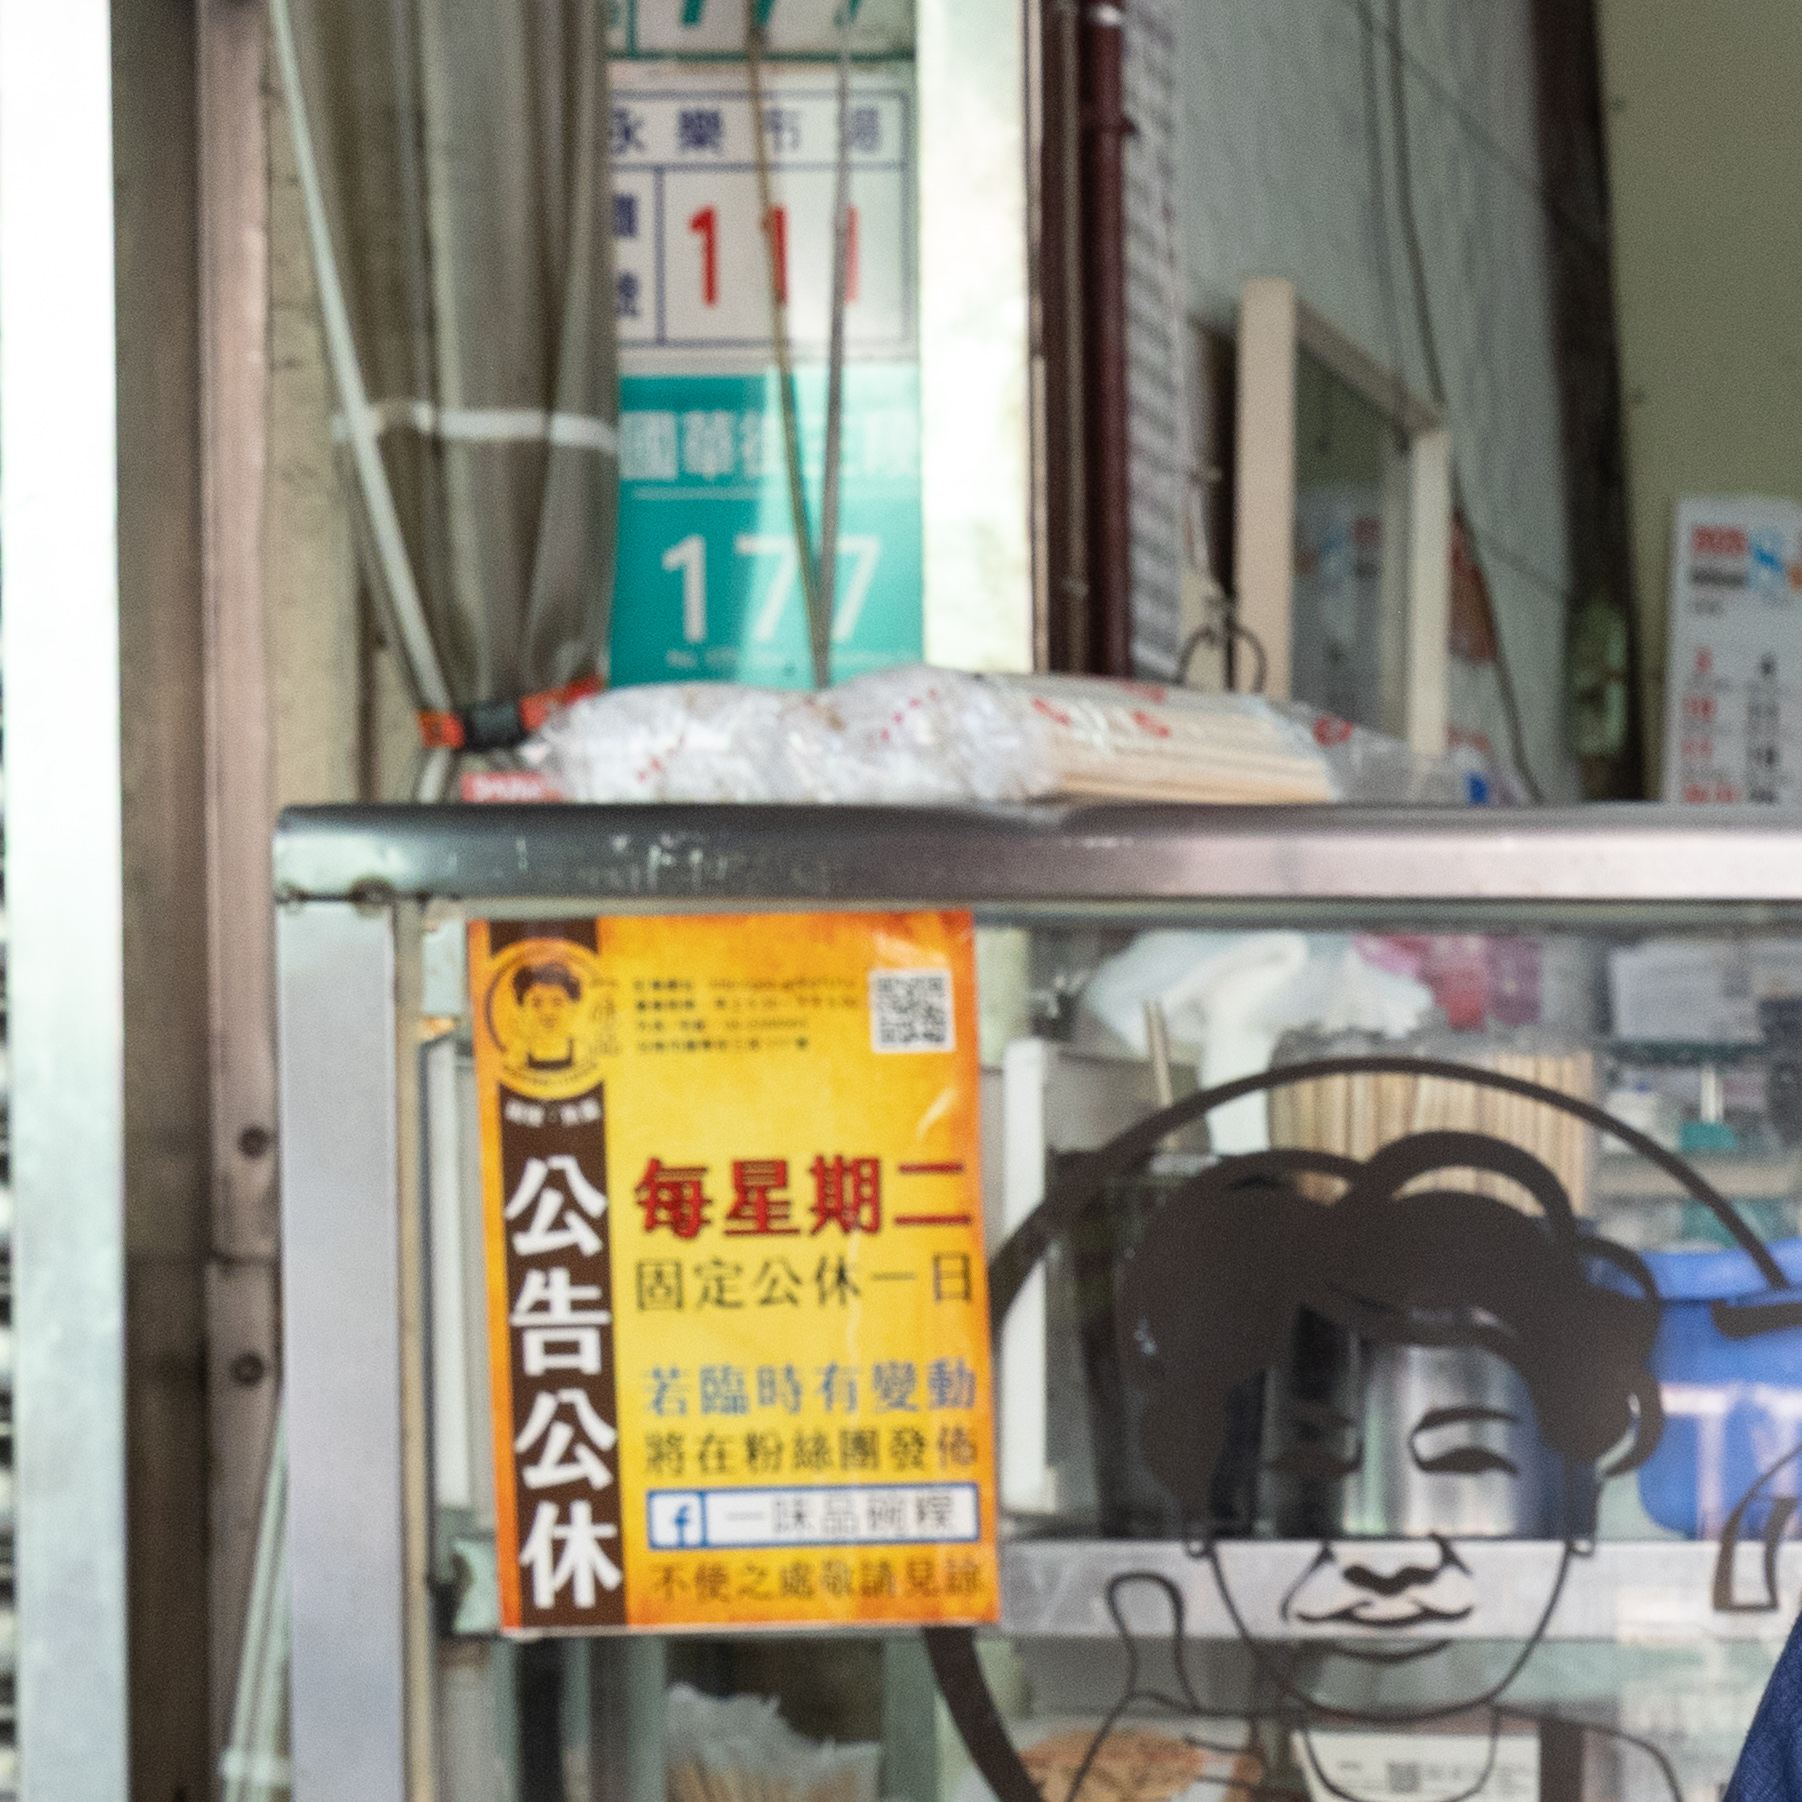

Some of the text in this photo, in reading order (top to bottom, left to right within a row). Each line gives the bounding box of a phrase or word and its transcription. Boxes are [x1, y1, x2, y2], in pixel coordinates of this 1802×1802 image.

[662, 535, 881, 642] 177
[634, 1153, 974, 1241] 每星期二
[635, 1251, 975, 1312] 固定公休一日
[504, 1154, 623, 1610] 公告公休
[643, 1358, 978, 1418] 若臨時有變動
